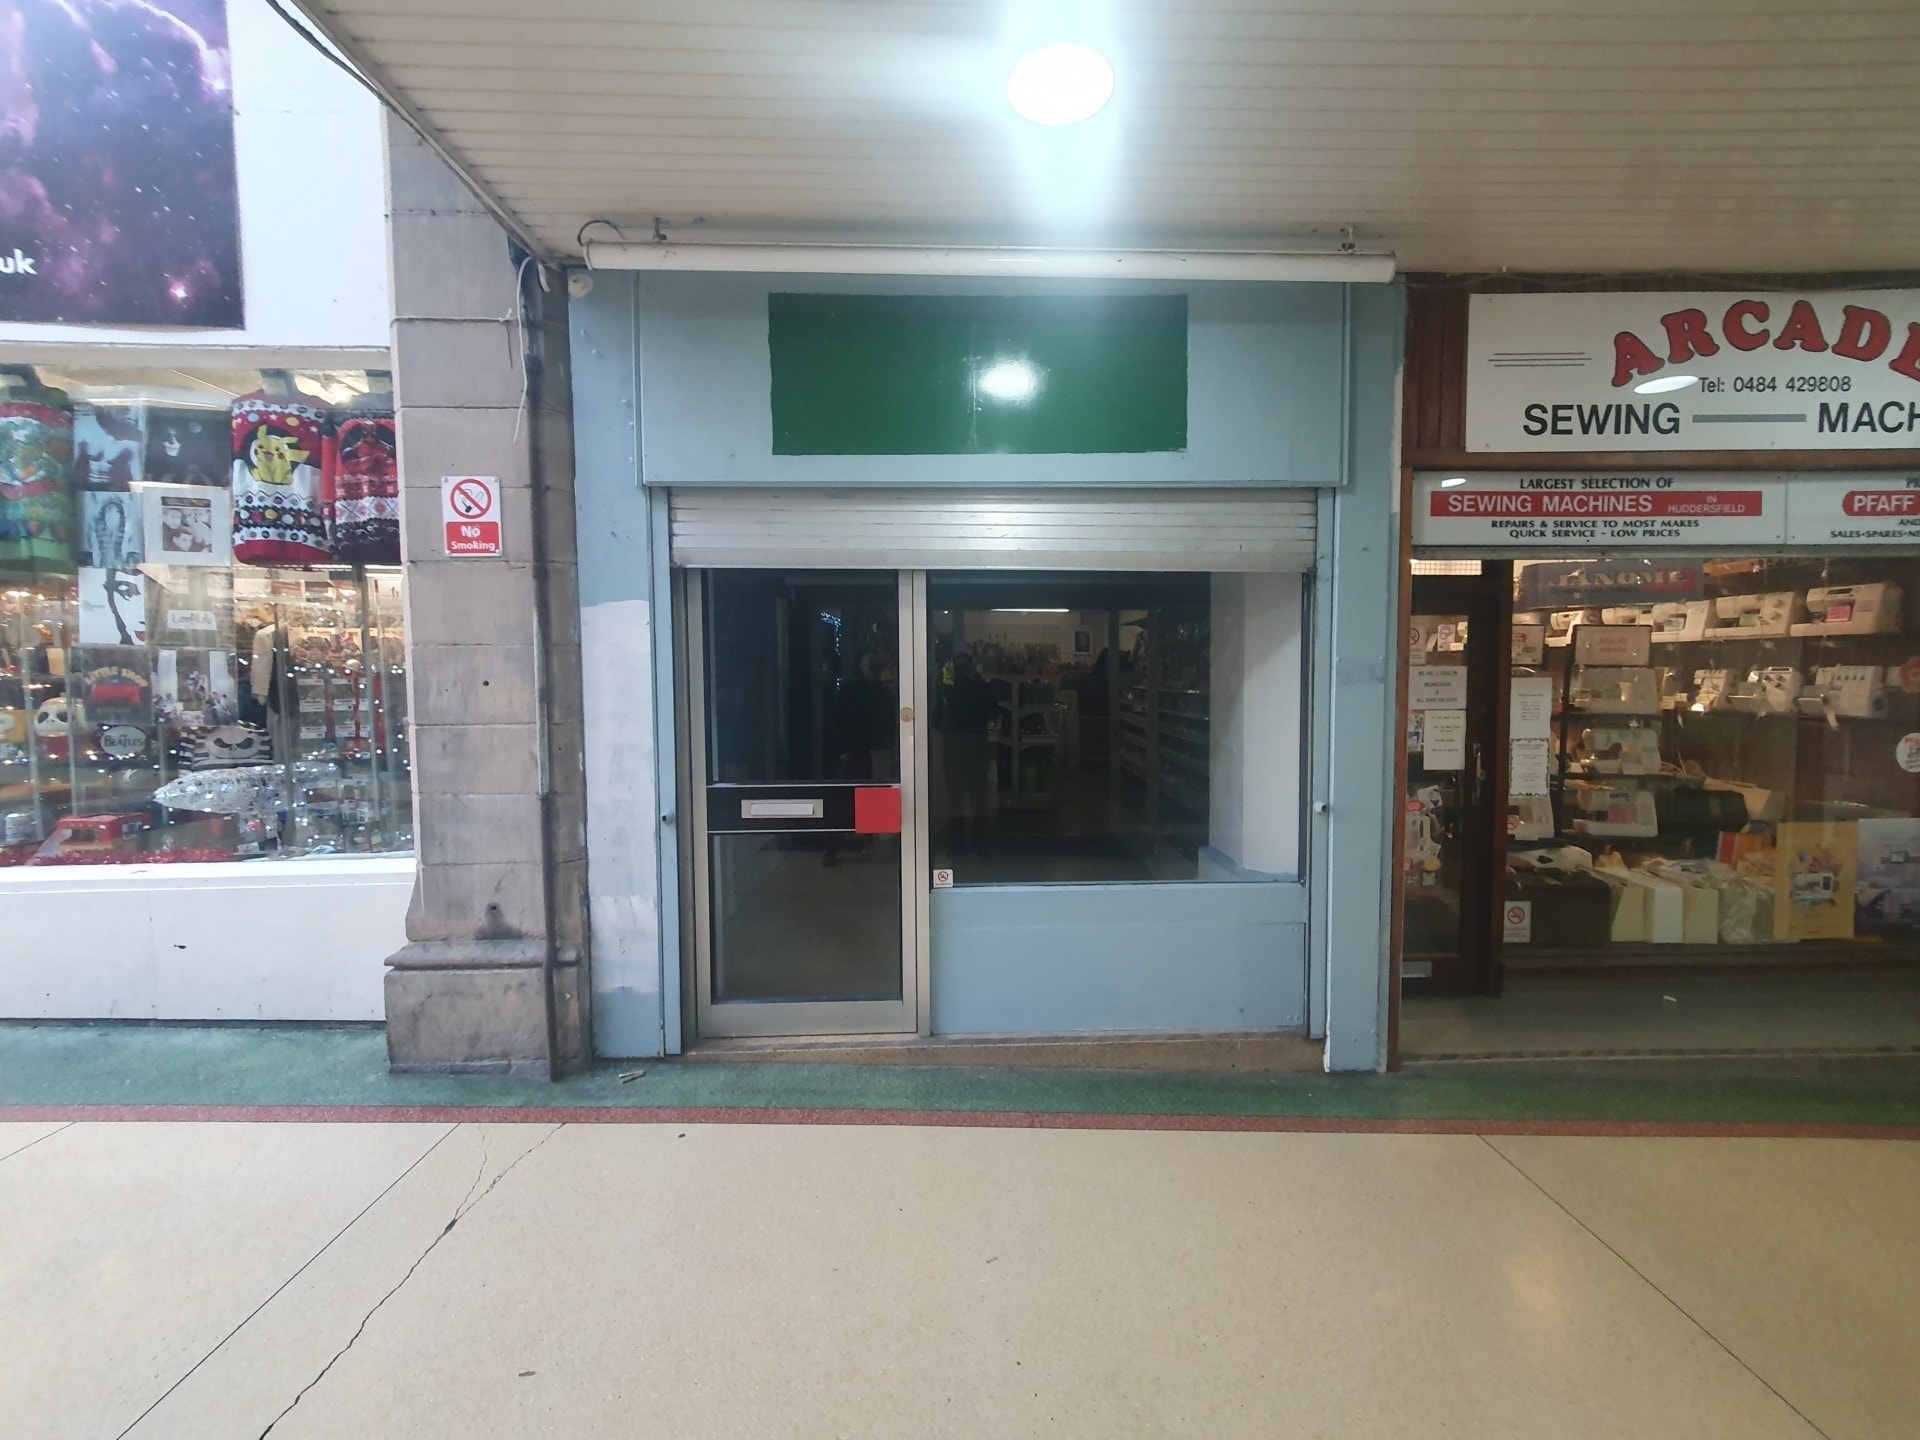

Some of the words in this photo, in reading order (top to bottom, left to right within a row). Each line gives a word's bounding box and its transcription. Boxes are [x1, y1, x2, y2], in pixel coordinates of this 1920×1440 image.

[1699, 376, 1725, 393] Tel:
[1733, 376, 1777, 393] 0484
[1785, 375, 1852, 393] 429808
[1523, 402, 1681, 436] SEWING
[1519, 478, 1575, 490] LARGEST
[1581, 477, 1651, 489] SELECTION
[1656, 476, 1675, 488] OF
[1448, 494, 1532, 513] SEWING
[1542, 494, 1653, 513] MACHINES
[1706, 495, 1717, 504] IN
[1853, 495, 1915, 512] PFAFF
[1667, 504, 1746, 514] HUDDERSFIELD
[1491, 520, 1535, 528] REPAIRS
[1540, 520, 1548, 528] &
[1553, 520, 1598, 528] SERVICE
[1603, 519, 1618, 528] TO
[1622, 519, 1656, 528] MOST
[1660, 519, 1700, 528] MAKES
[460, 525, 481, 538] No
[1509, 530, 1547, 539] QUICK
[1551, 529, 1596, 538] SERVICE
[1611, 529, 1637, 538] LOW
[1642, 529, 1681, 538] PRICES
[451, 540, 496, 552] Smoking
